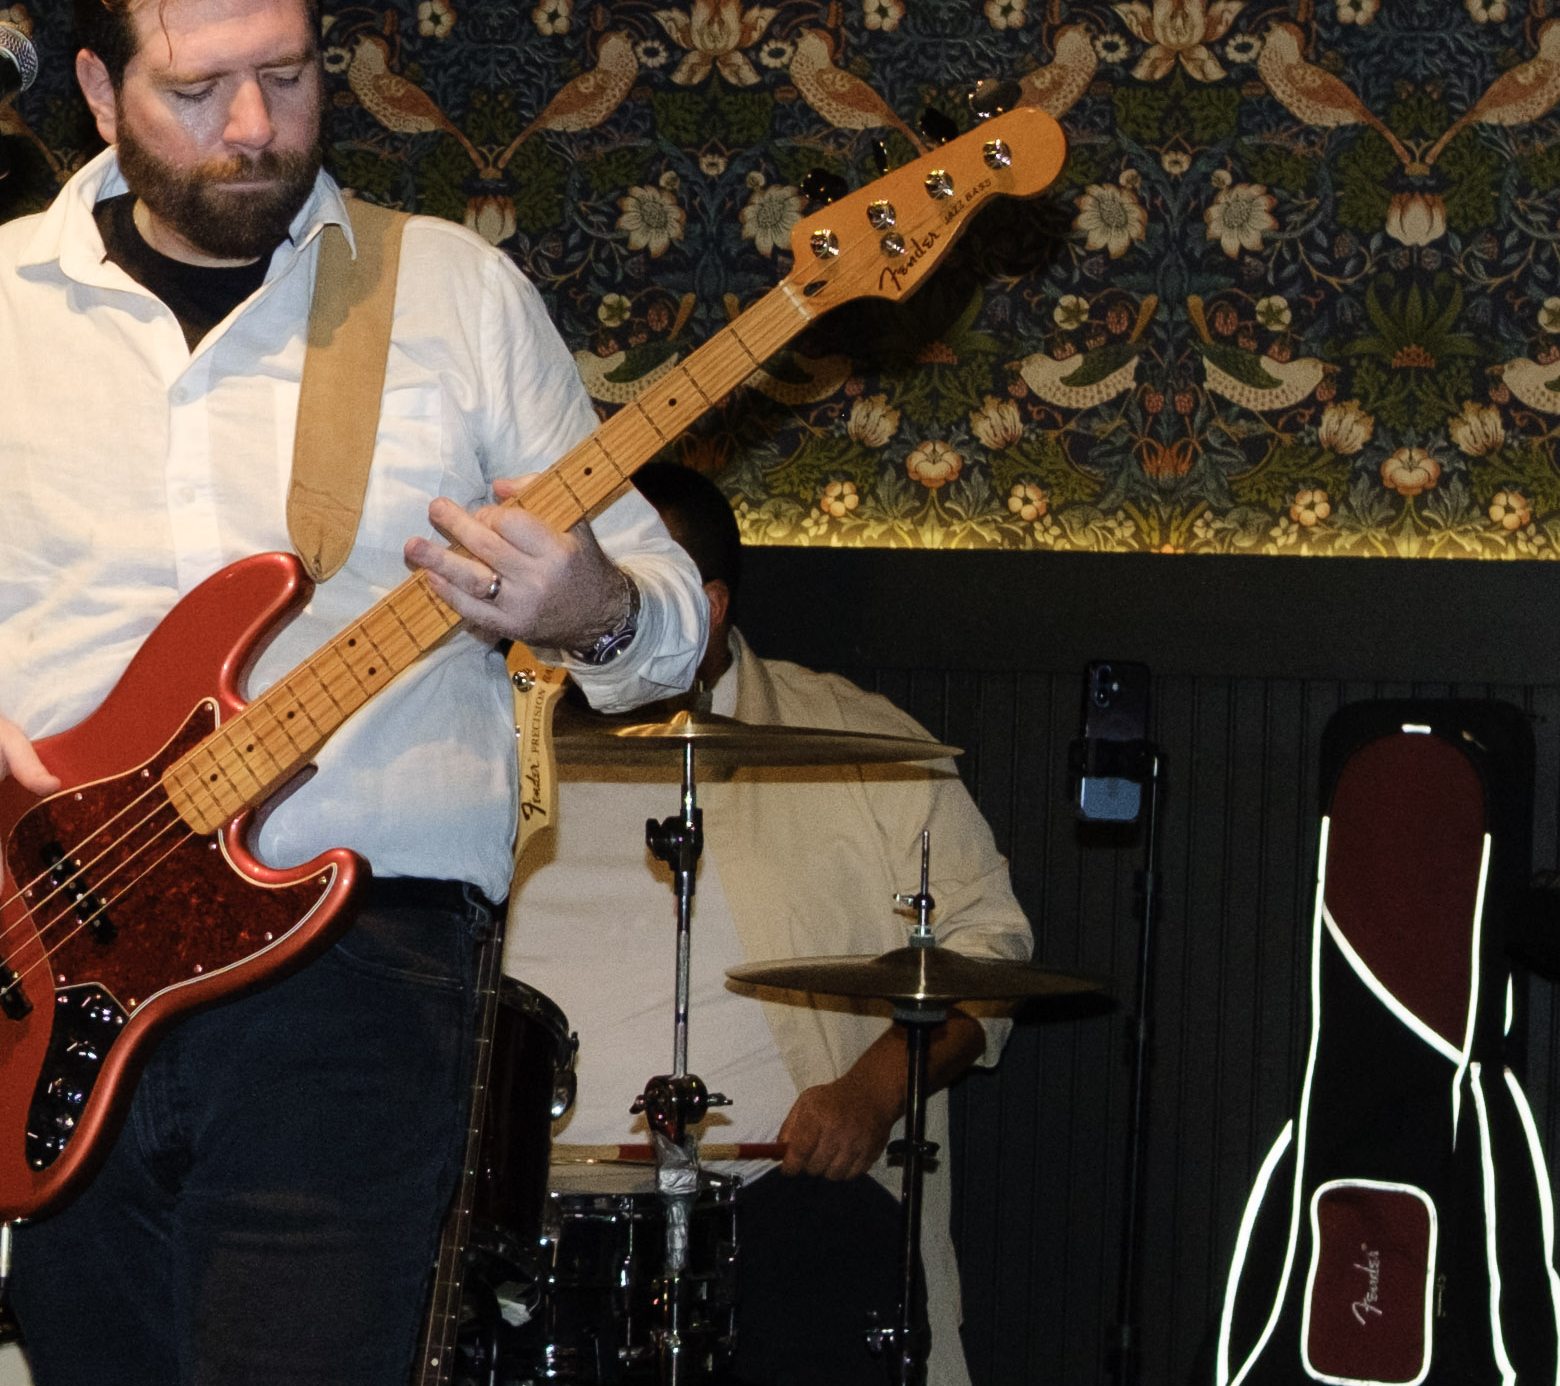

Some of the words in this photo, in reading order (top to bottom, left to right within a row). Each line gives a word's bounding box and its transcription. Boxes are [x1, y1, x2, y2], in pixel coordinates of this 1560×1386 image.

[878, 231, 941, 291] Fender
[944, 200, 965, 226] JAZZ
[964, 178, 992, 202] BASS
[530, 686, 546, 755] PRECISION
[521, 762, 547, 821] Fender
[1352, 1248, 1383, 1326] Fender
